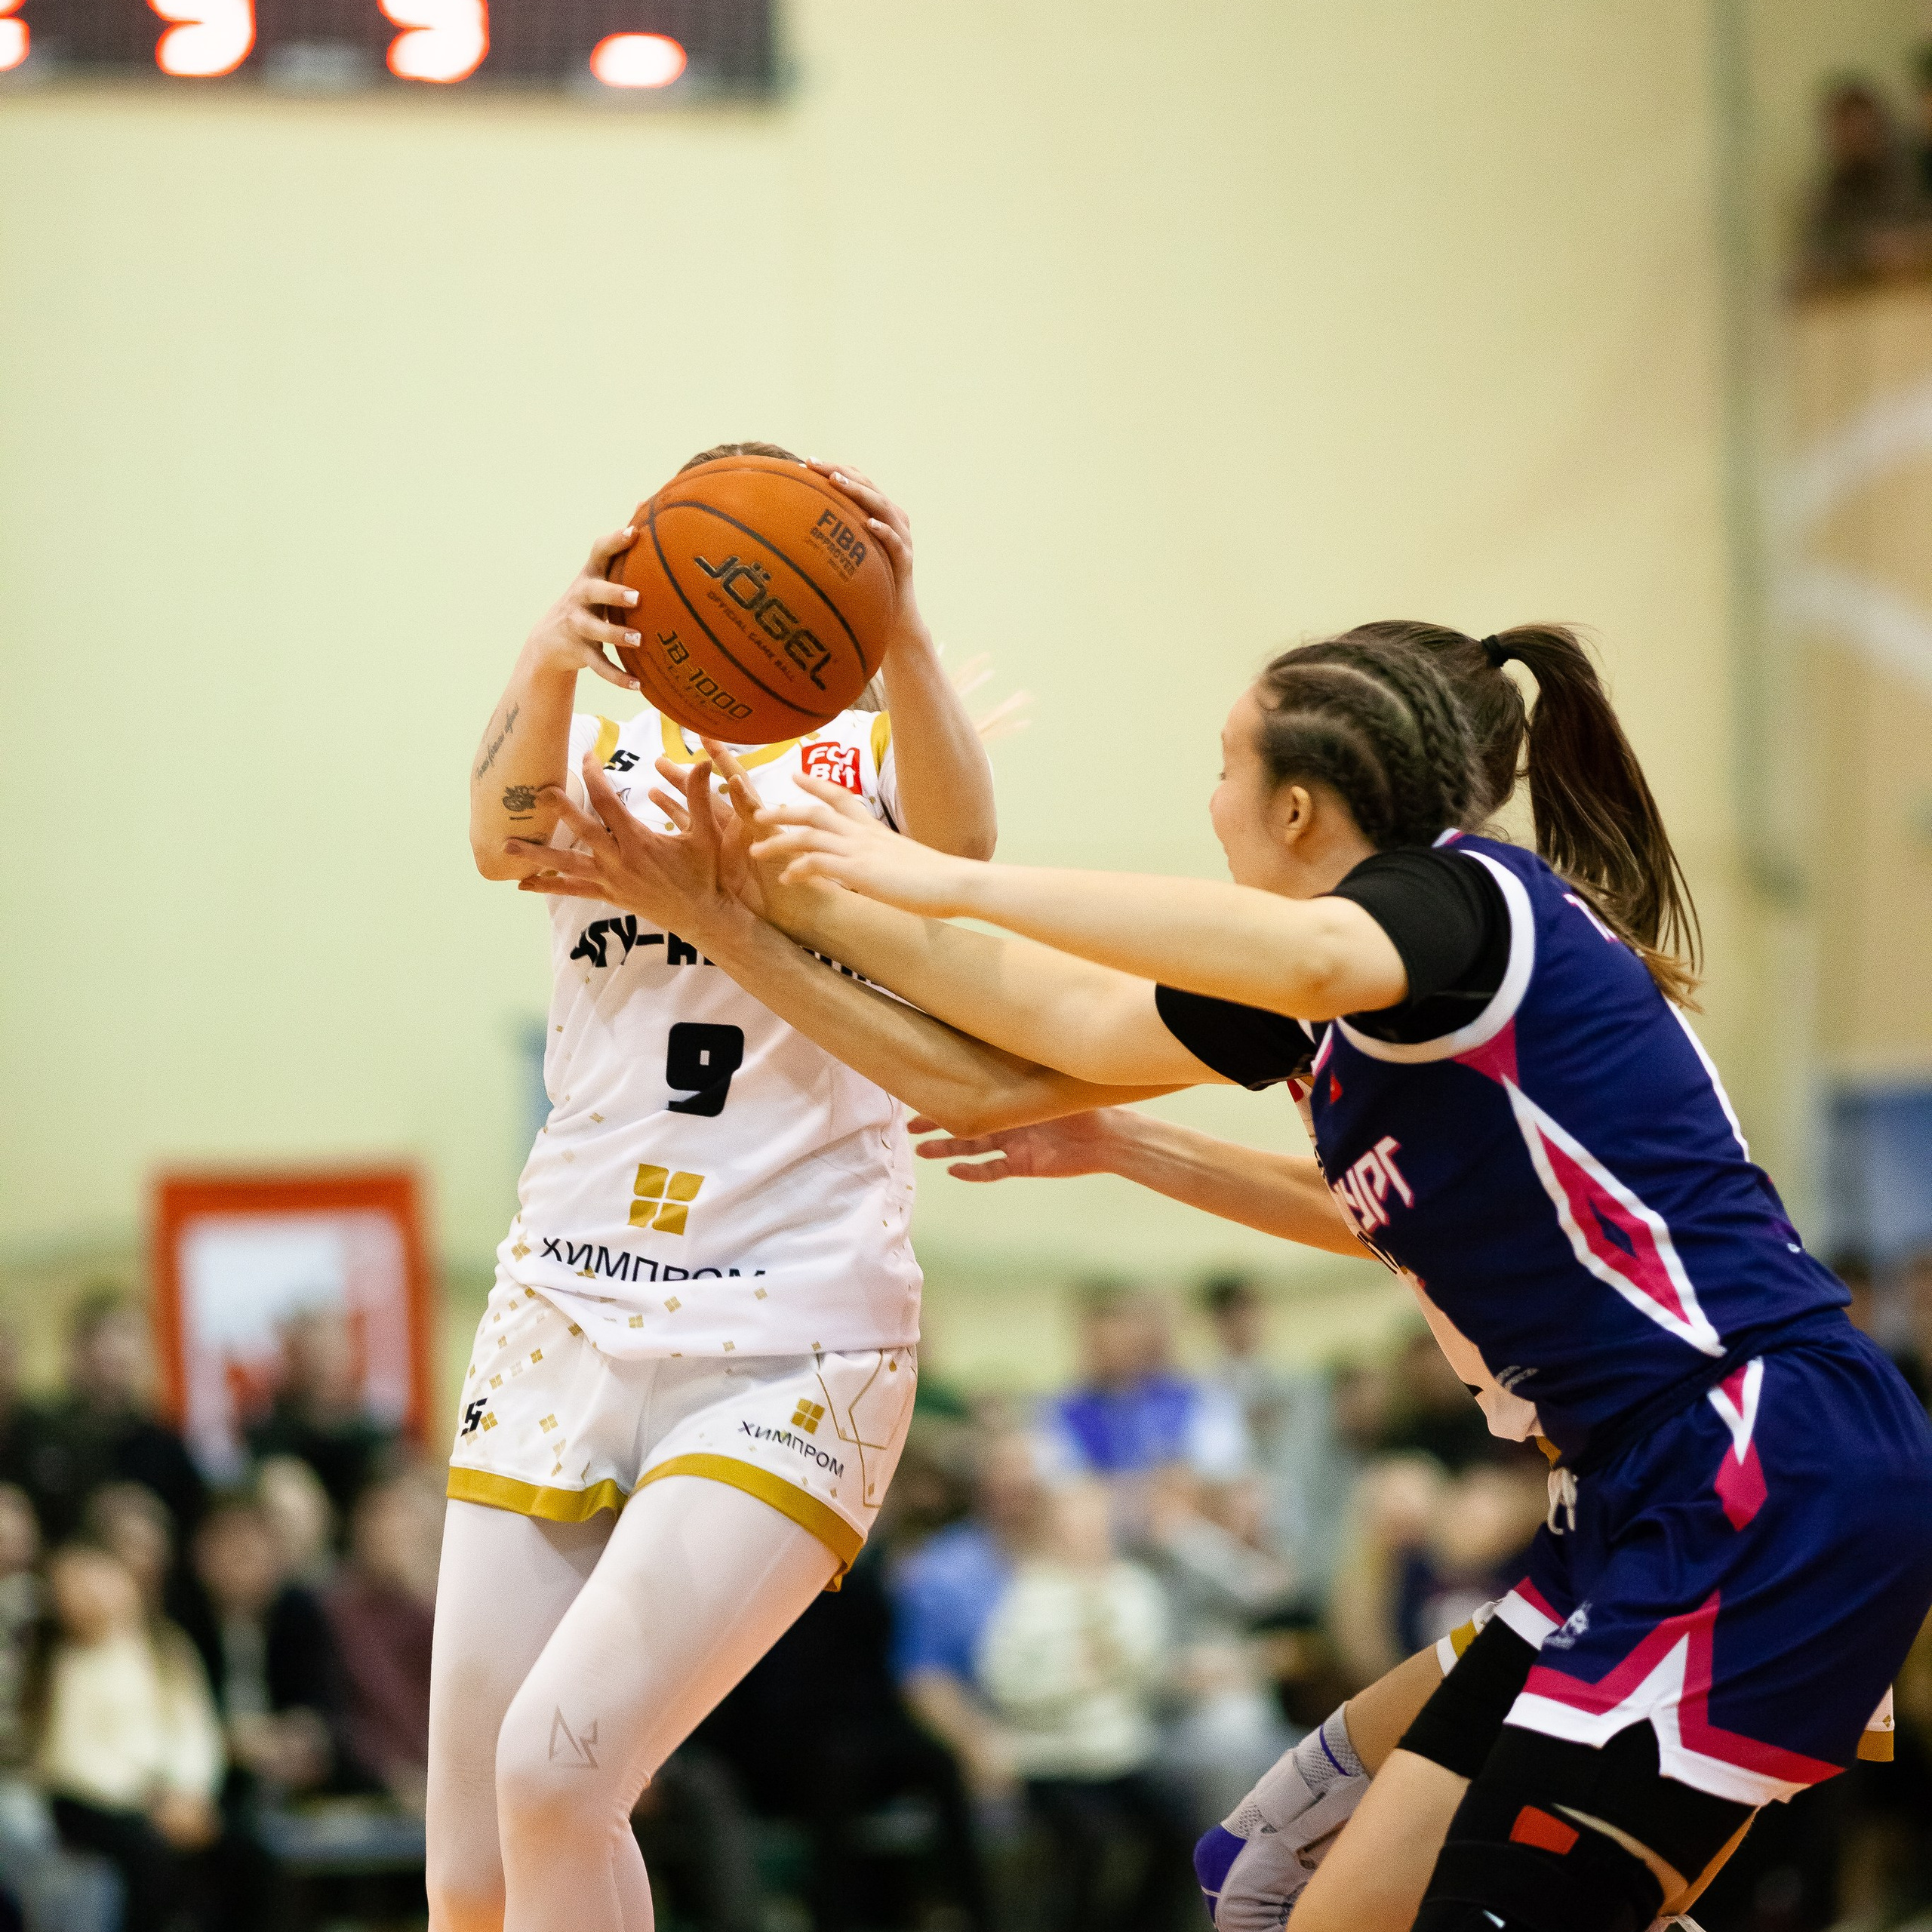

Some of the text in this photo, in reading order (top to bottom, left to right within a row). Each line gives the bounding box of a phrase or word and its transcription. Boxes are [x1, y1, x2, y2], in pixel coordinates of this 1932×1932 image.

[817, 508, 866, 568] FIBA
[693, 555, 832, 692] JÖGEL
[665, 1021, 745, 1118] 9
[737, 1420, 845, 1479] ХИМПРОМ
